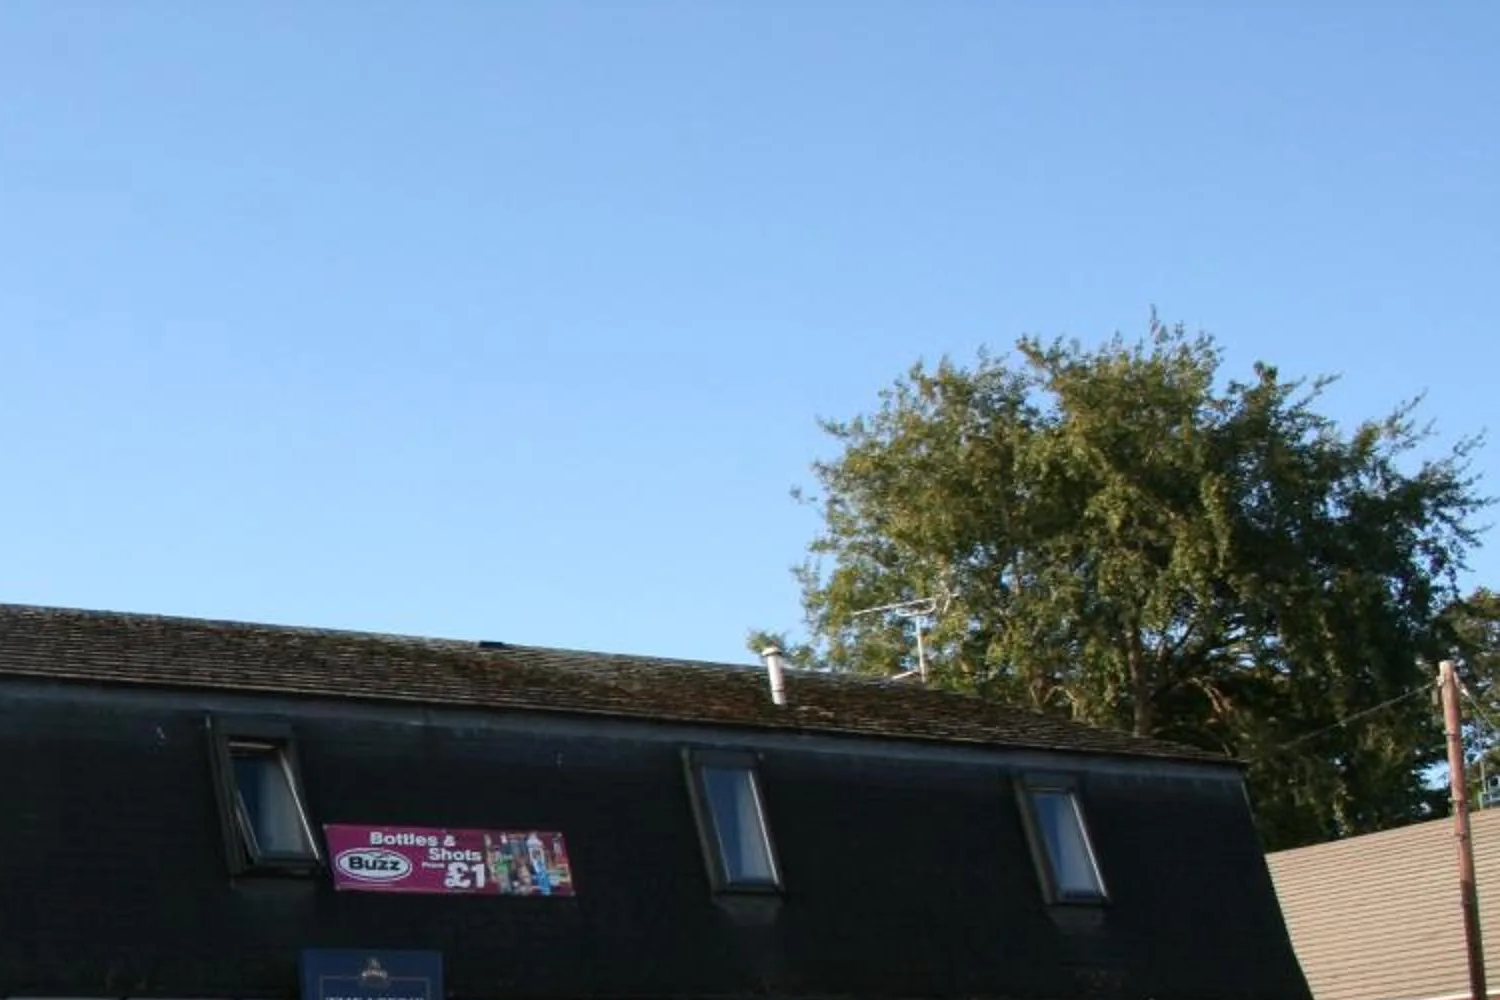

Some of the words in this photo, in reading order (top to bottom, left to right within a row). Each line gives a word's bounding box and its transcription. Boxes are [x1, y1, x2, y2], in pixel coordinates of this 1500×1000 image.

[370, 832, 438, 847] Bottles
[443, 834, 456, 847] &
[428, 847, 481, 861] Shots
[349, 856, 401, 871] Buzz
[444, 862, 486, 888] £1
